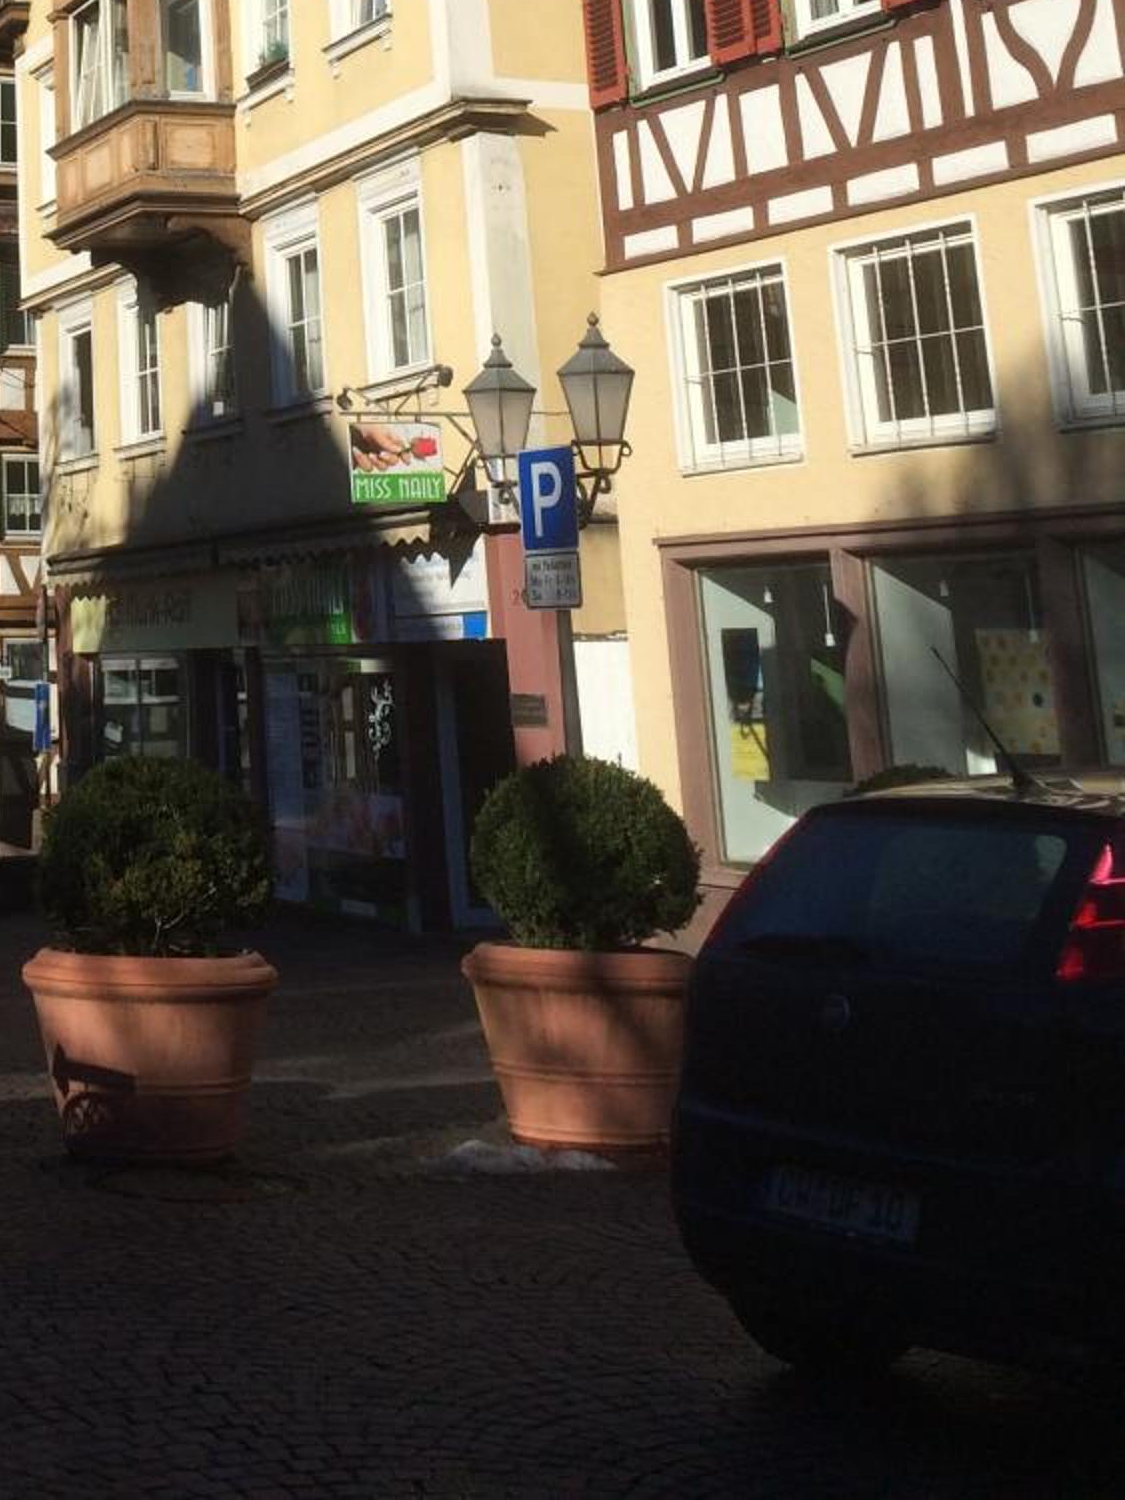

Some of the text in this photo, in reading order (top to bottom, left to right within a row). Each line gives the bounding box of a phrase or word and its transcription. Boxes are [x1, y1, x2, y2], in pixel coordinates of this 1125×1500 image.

[355, 477, 442, 500] MISS NAILY
[530, 461, 563, 538] P
